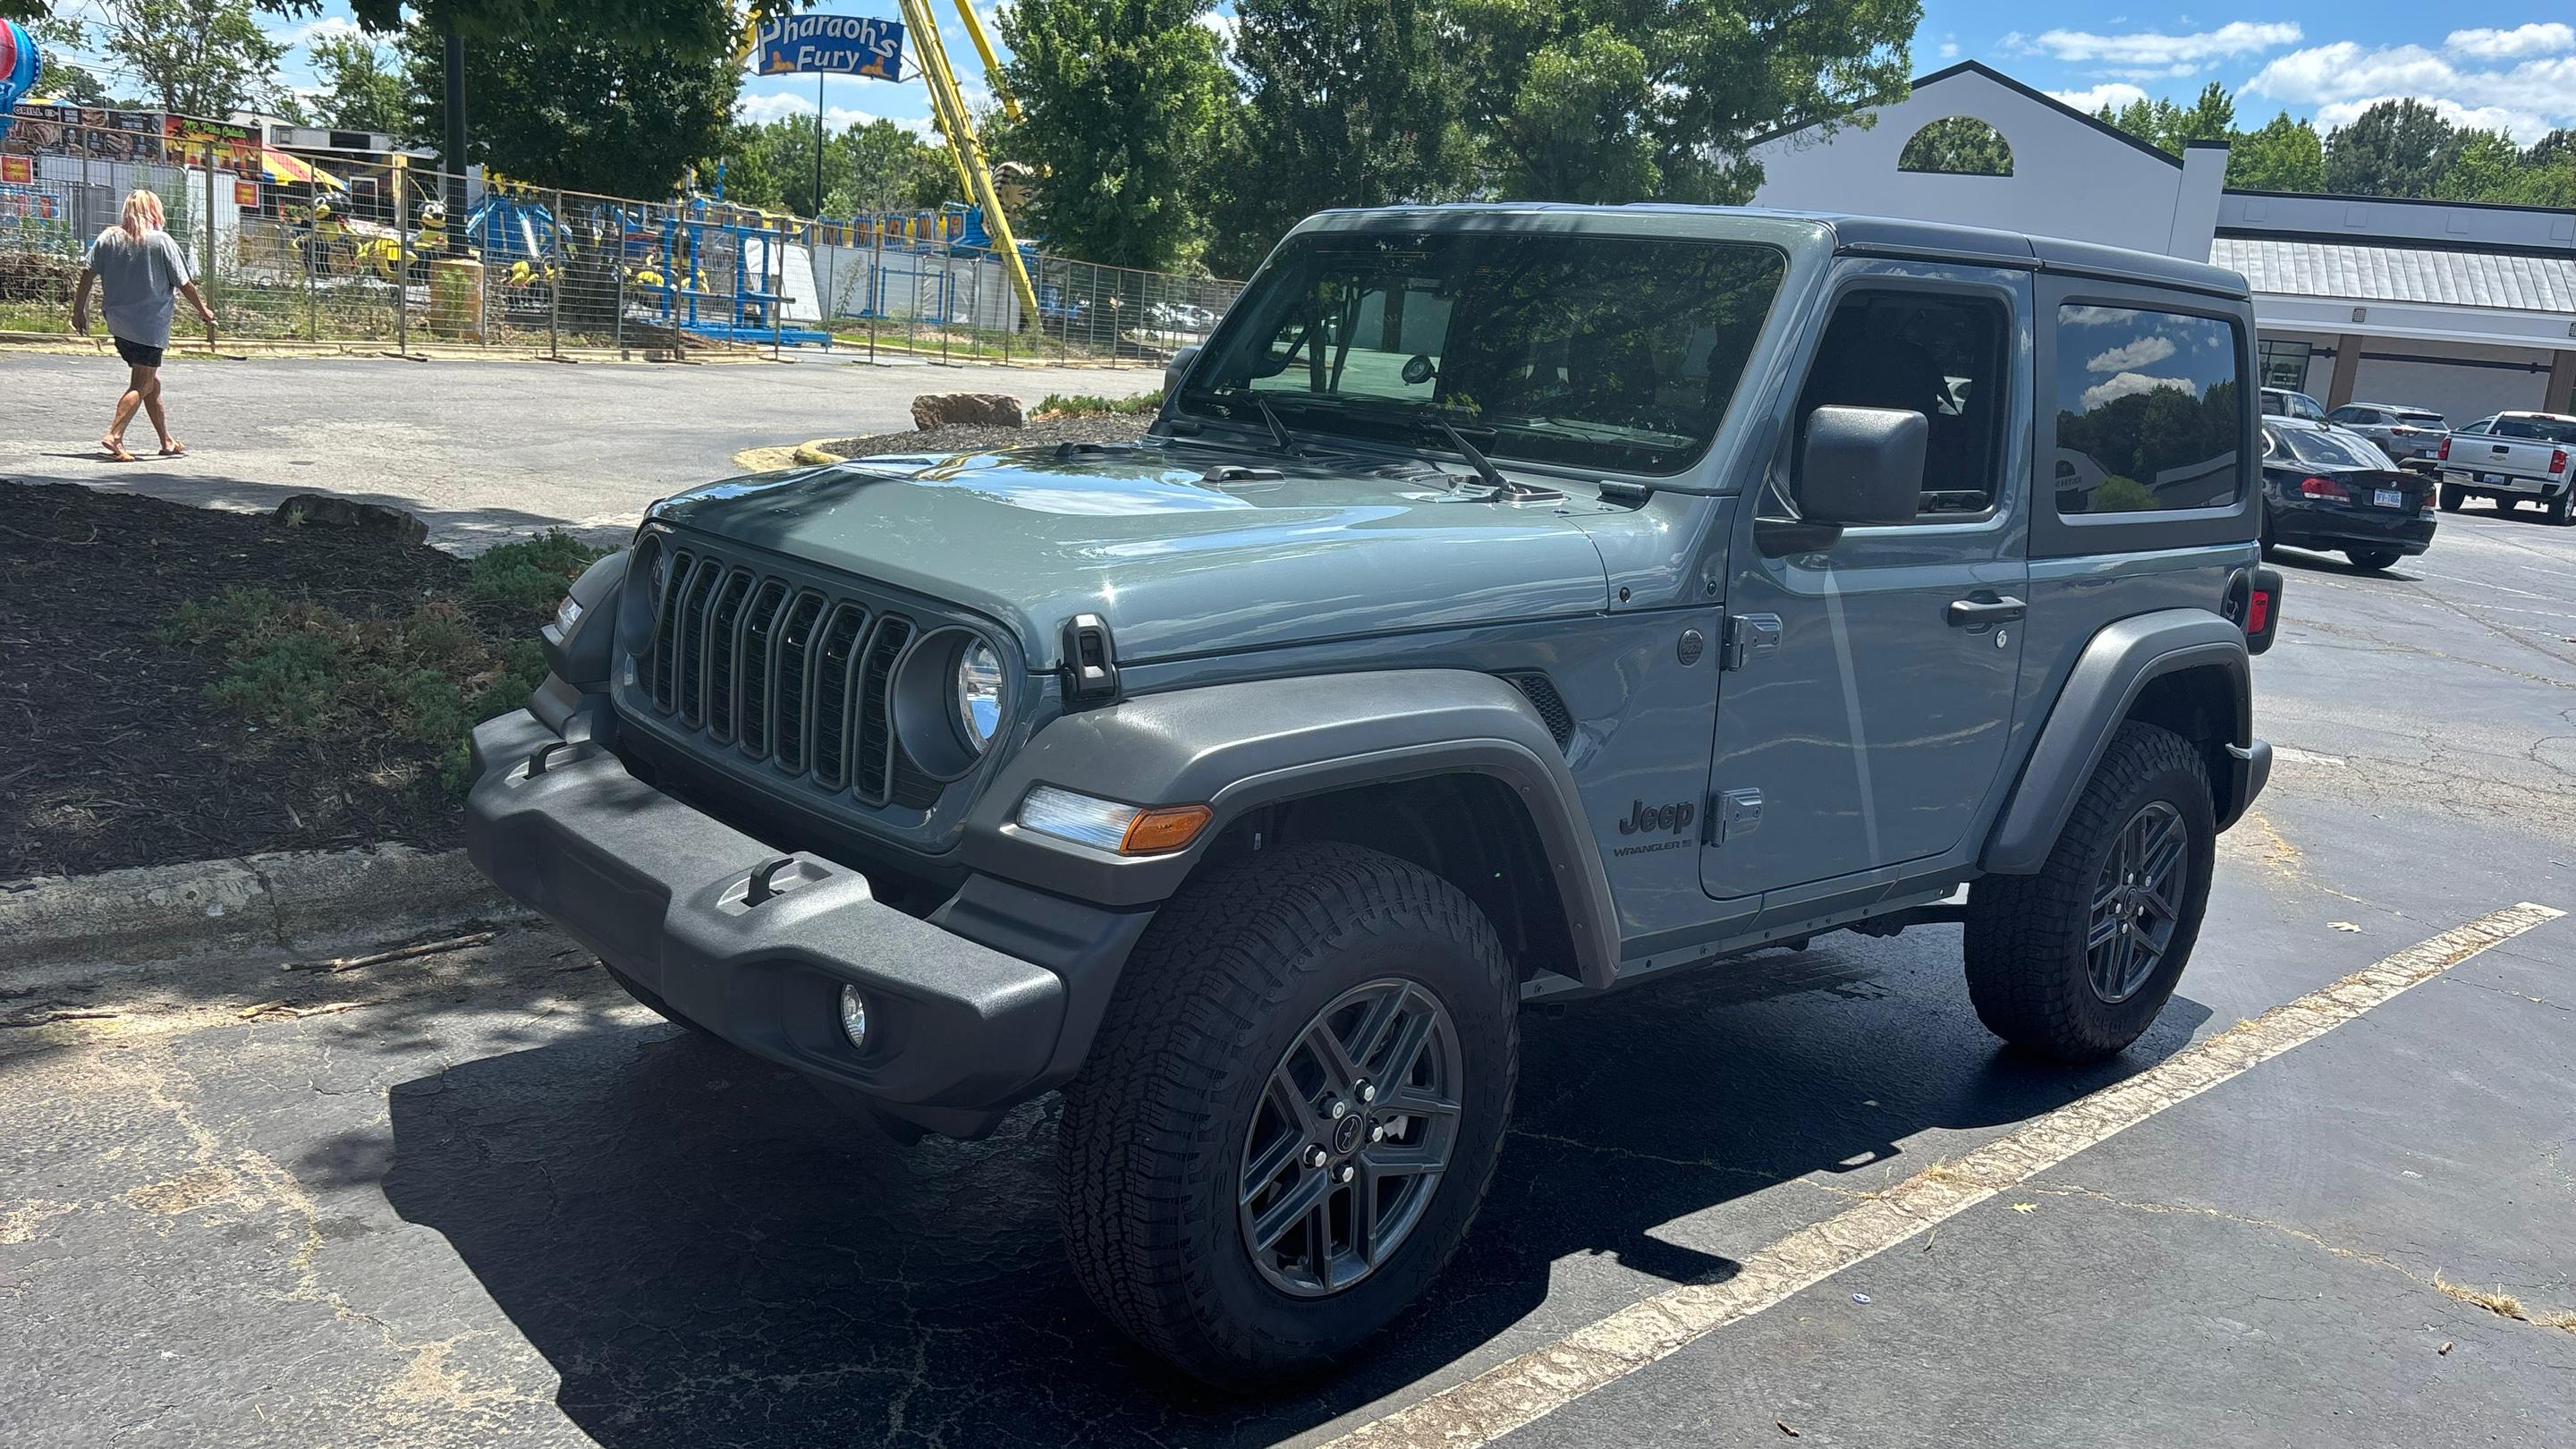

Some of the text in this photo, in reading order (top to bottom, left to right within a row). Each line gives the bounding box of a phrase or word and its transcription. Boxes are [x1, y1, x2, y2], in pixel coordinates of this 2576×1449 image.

[758, 16, 898, 64] Pharaoh's
[796, 46, 860, 72] Fury
[13, 106, 43, 116] GRILL
[1619, 800, 1695, 835] Jeep
[1613, 841, 1681, 857] WRANGLER
